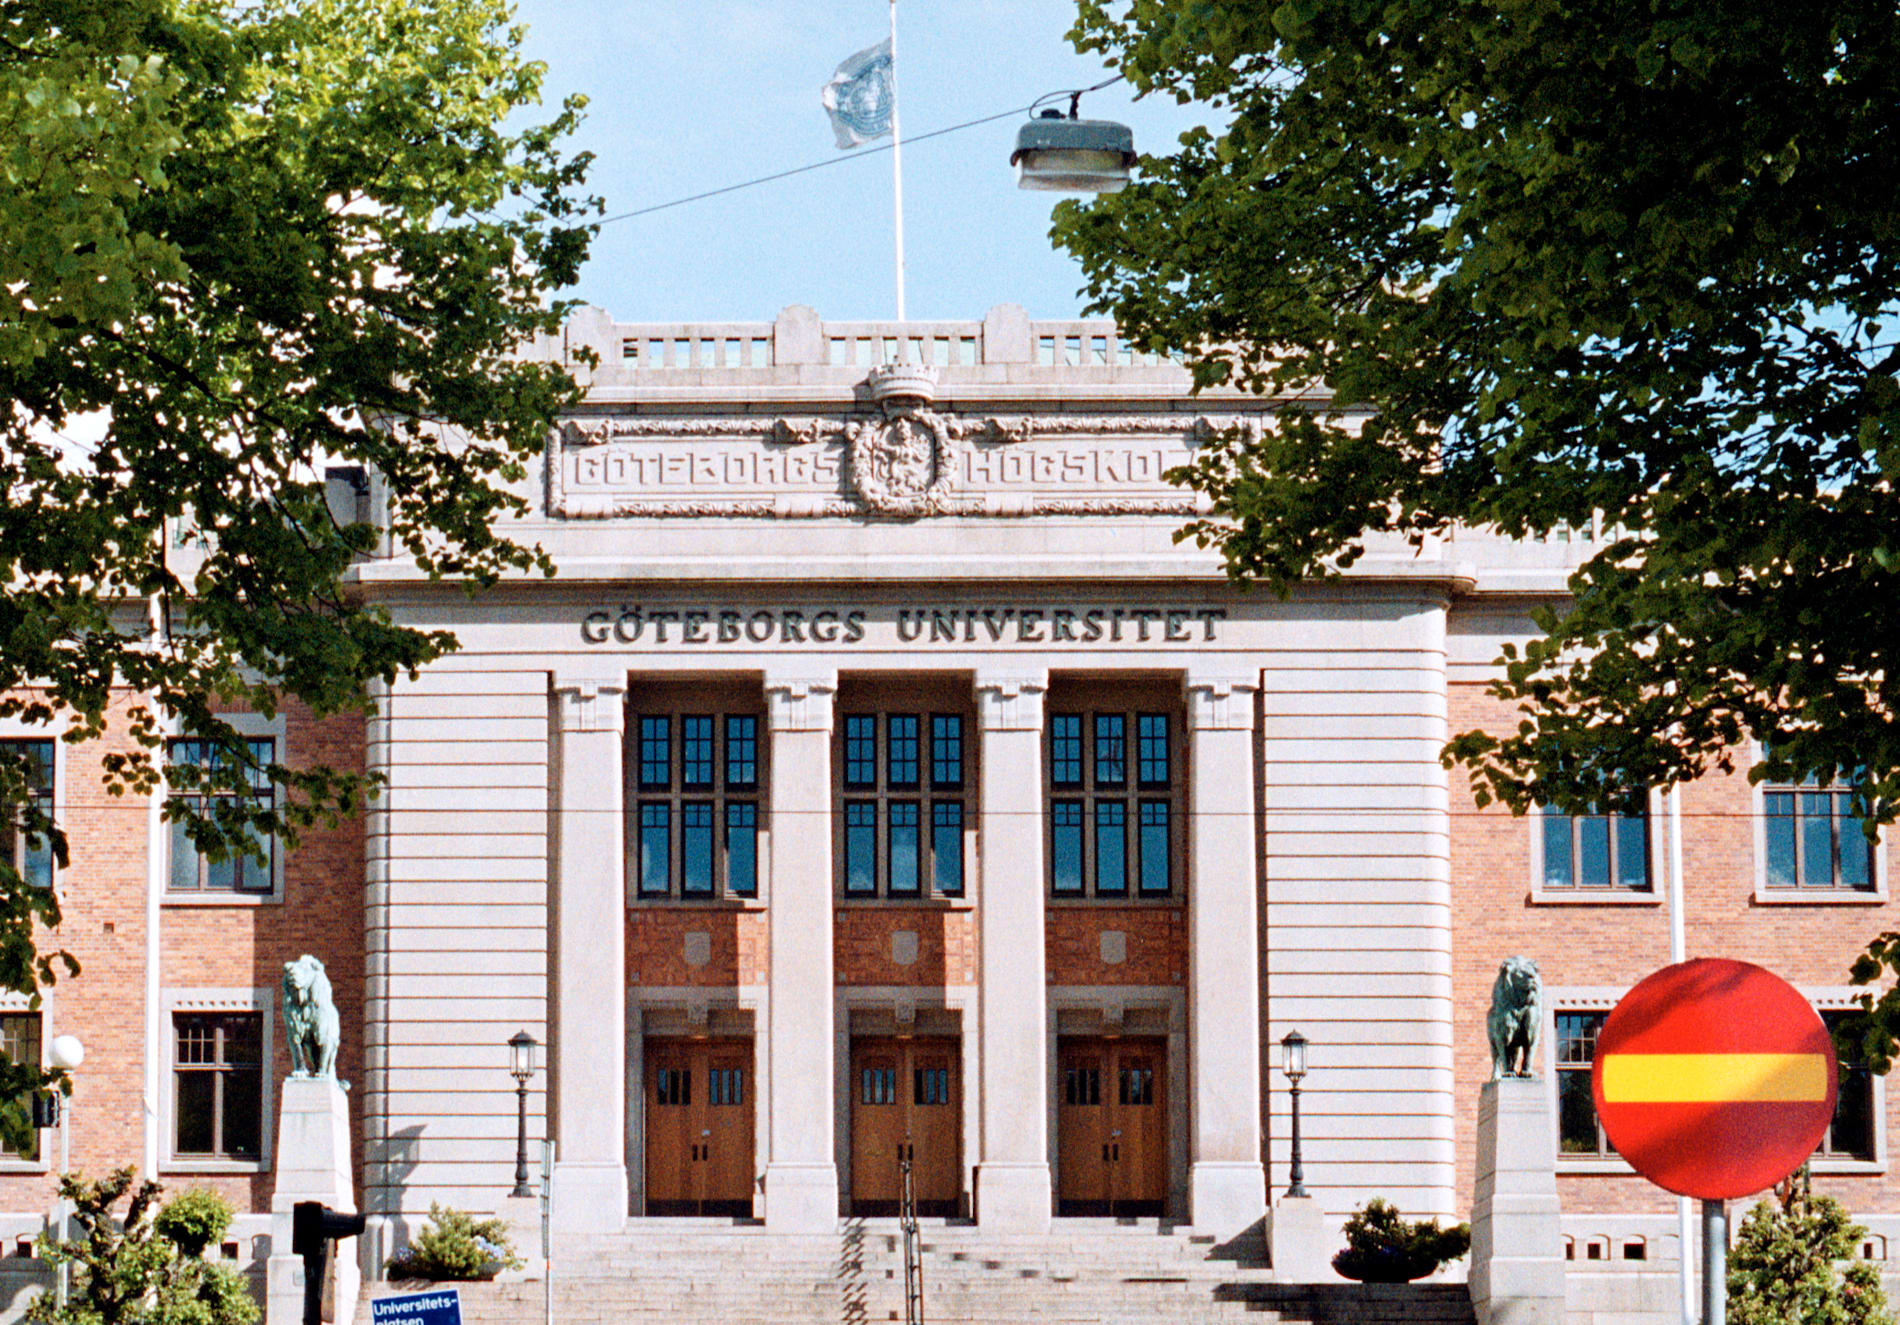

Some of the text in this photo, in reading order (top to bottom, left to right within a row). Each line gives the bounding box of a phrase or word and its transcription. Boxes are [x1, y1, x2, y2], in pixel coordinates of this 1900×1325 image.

[960, 446, 1206, 484] HÖGSKOL
[580, 604, 1227, 644] GÖTEBORGS UNIVERSITET
[373, 1296, 457, 1316] Universitets-
[376, 1317, 425, 1325] latsen
